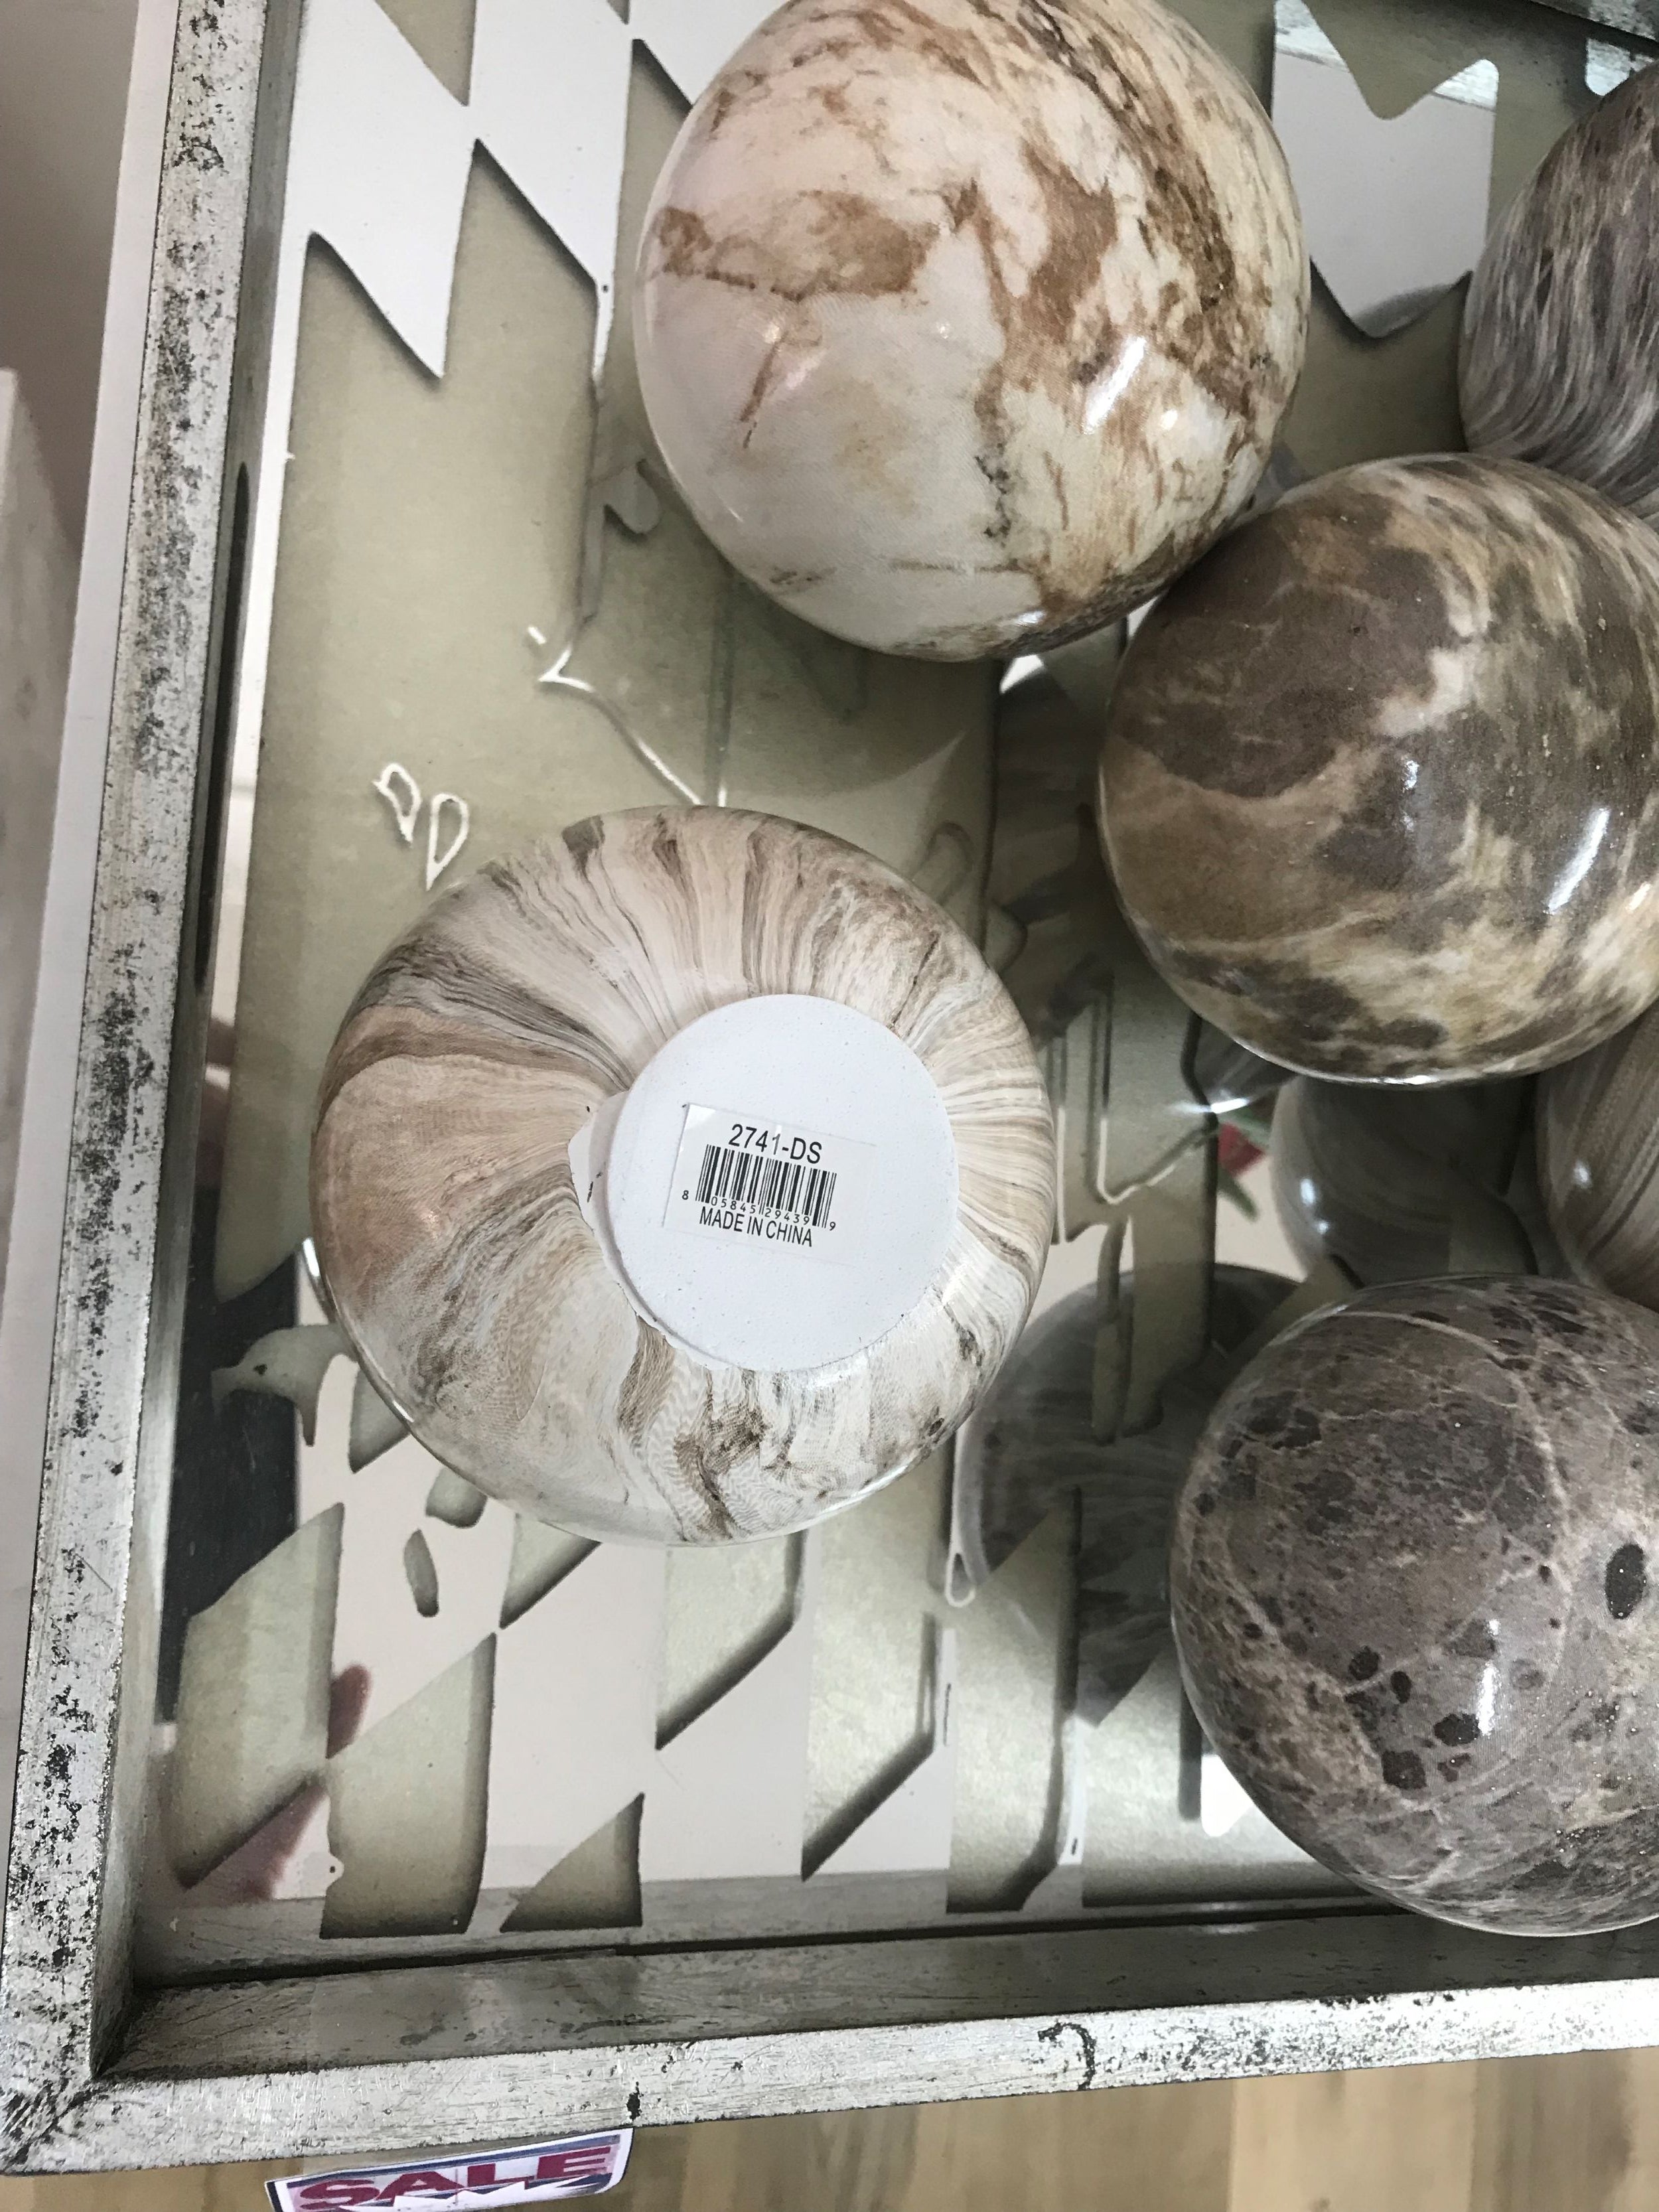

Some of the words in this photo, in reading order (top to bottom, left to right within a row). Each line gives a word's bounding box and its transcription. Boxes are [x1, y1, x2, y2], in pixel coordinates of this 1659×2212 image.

[729, 1124, 822, 1164] 2741-DS
[699, 1206, 745, 1232] MADE
[747, 1216, 763, 1236] IN
[766, 1220, 812, 1248] CHINA
[299, 2146, 612, 2211] SALE
